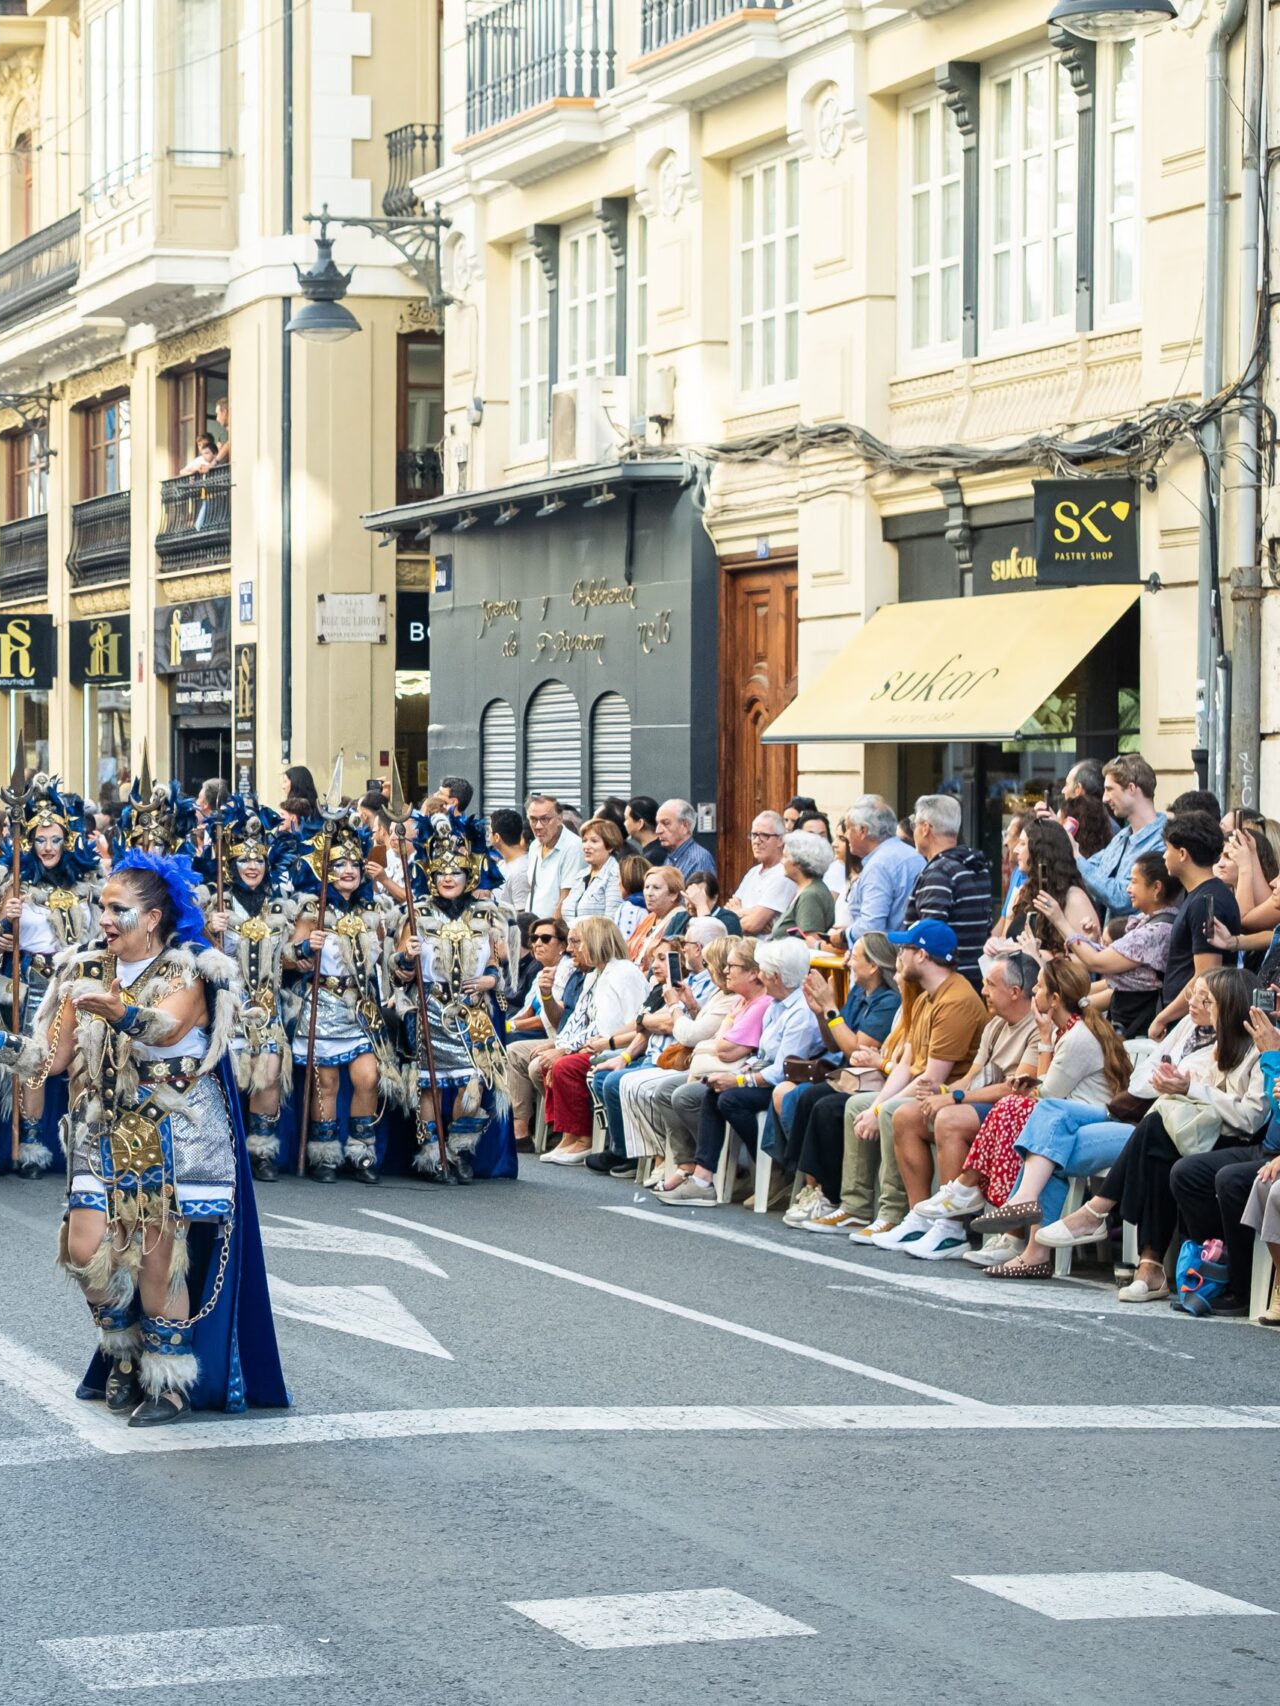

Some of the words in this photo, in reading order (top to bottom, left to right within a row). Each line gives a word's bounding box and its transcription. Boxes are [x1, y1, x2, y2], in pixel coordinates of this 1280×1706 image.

[991, 547, 1037, 582] suka
[1054, 552, 1086, 561] PASTRY
[1090, 551, 1113, 561] SHOP
[321, 616, 337, 626] RUIZ
[341, 616, 351, 626] DE
[410, 622, 430, 641] B
[870, 653, 999, 701] sukar
